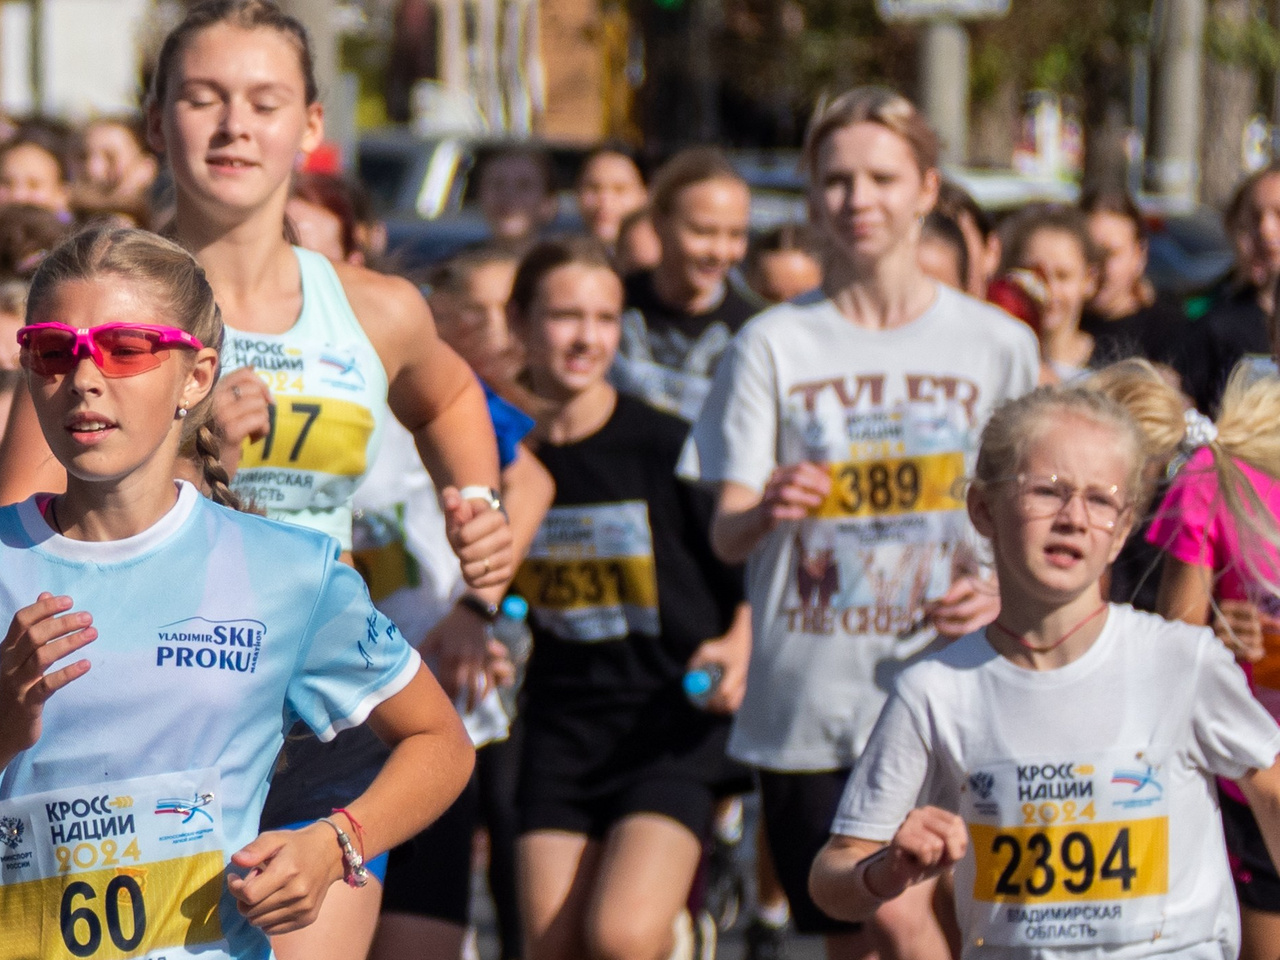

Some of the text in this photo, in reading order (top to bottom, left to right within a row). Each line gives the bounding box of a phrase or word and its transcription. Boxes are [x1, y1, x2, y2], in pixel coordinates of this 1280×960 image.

[233, 339, 285, 356] КРОСС
[235, 354, 304, 371] НАЦИИ
[837, 461, 921, 514] 389
[158, 625, 254, 648] VLADIMIR SKI
[156, 646, 251, 672] PROKU
[250, 630, 262, 674] MARATHON
[1017, 764, 1074, 781] КРОСС
[1018, 781, 1094, 801] НАЦИИ
[45, 794, 112, 823] КРОСС
[1022, 800, 1097, 824] 2024
[50, 814, 136, 845] НАЦИИ
[55, 836, 143, 873] 2024
[990, 827, 1137, 896] 2394
[59, 874, 148, 958] 60
[1025, 922, 1098, 940] ОБЛАСТЬ
